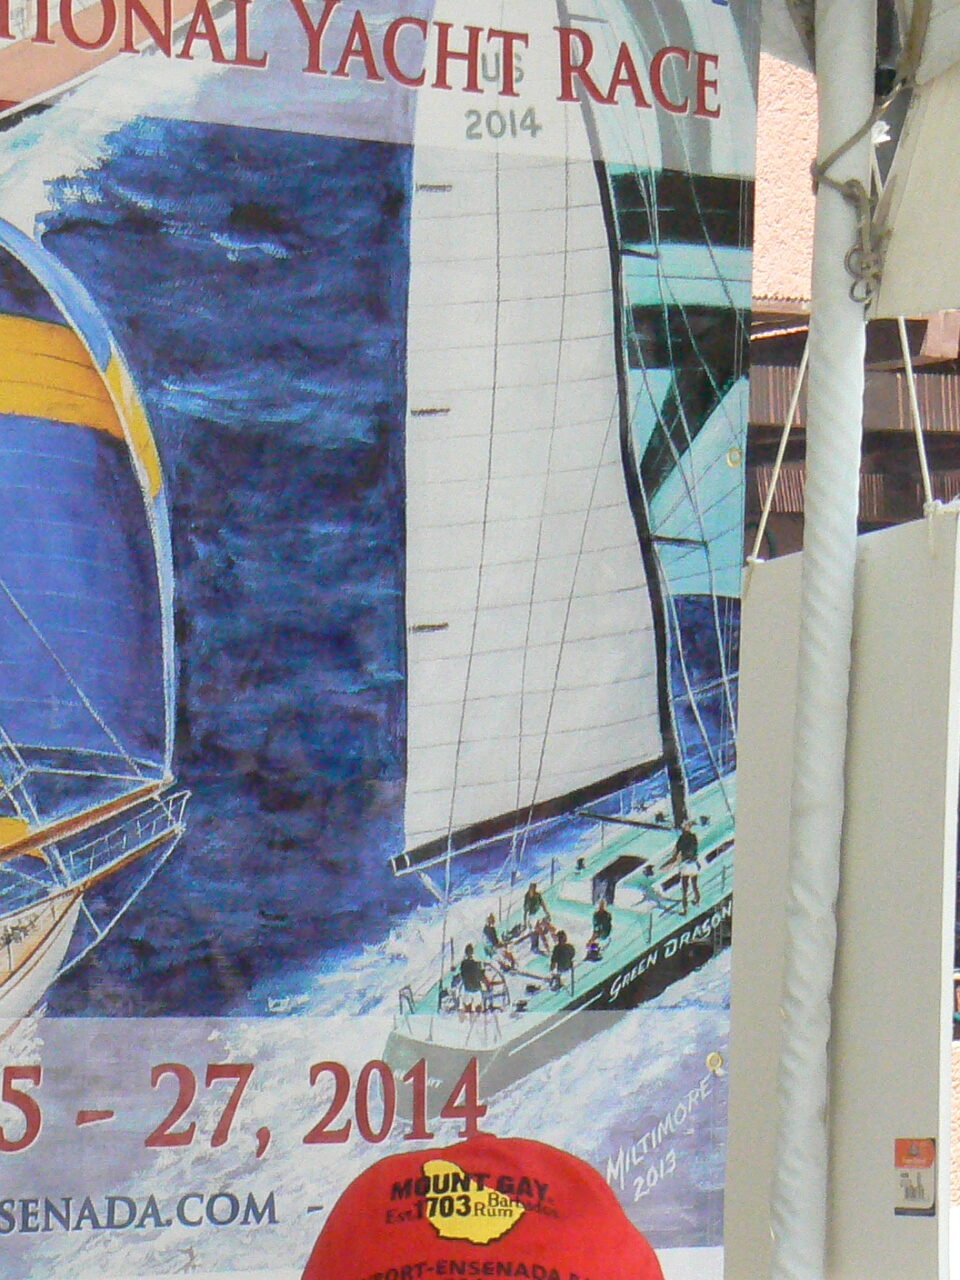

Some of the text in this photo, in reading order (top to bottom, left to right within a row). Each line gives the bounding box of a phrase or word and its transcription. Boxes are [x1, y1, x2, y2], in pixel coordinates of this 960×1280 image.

[289, 0, 529, 97] YACHT
[553, 26, 722, 119] RACE
[464, 106, 542, 140] 2014
[609, 950, 659, 1003] GREEN
[75, 1109, 114, 1126] -
[144, 1062, 271, 1158] 27,
[303, 1058, 487, 1145] 2014
[606, 1071, 713, 1191] MILTIMORE
[391, 1171, 549, 1202] MOUNT GAY
[633, 1148, 677, 1202] 2013
[474, 1201, 514, 1218] Rum
